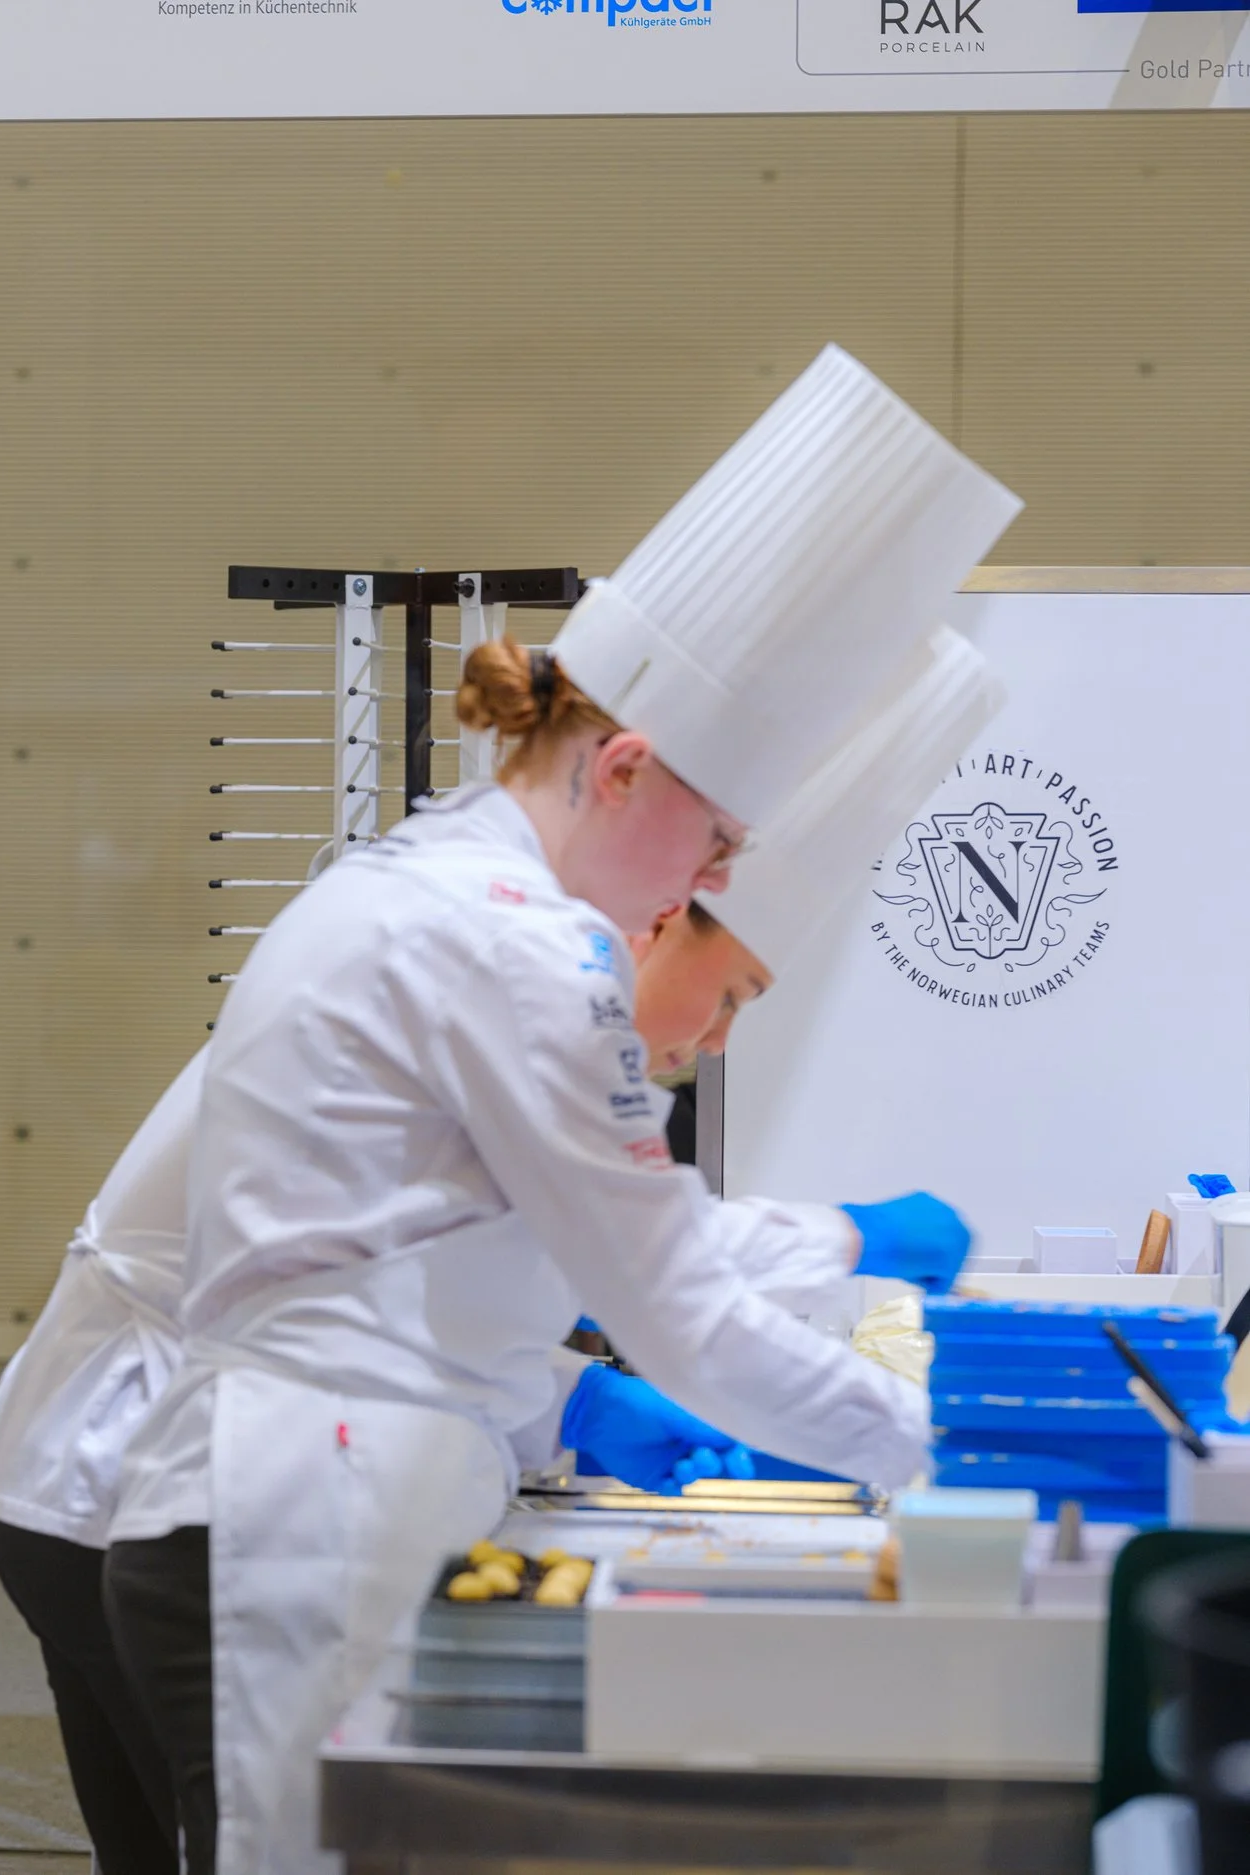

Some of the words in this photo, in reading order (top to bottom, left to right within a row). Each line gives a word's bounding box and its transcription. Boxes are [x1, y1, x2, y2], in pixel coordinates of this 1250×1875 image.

[158, 1, 234, 18] Kompetenz
[239, 1, 250, 14] in
[256, 0, 357, 14] Küchentechnik
[881, 0, 984, 34] RAK
[620, 17, 677, 28] Kühlgeräte
[680, 17, 711, 26] GmbH
[880, 42, 985, 53] PORCELAIN
[1141, 60, 1189, 78] Gold
[985, 753, 1033, 779] ART
[1045, 772, 1118, 872] PASSION
[951, 841, 1027, 923] N
[871, 921, 891, 942] BY
[884, 944, 909, 971] THE
[907, 967, 998, 1008] NORWEGIAN
[1004, 965, 1074, 1007] CULINARY
[1073, 921, 1110, 967] TEAMS
